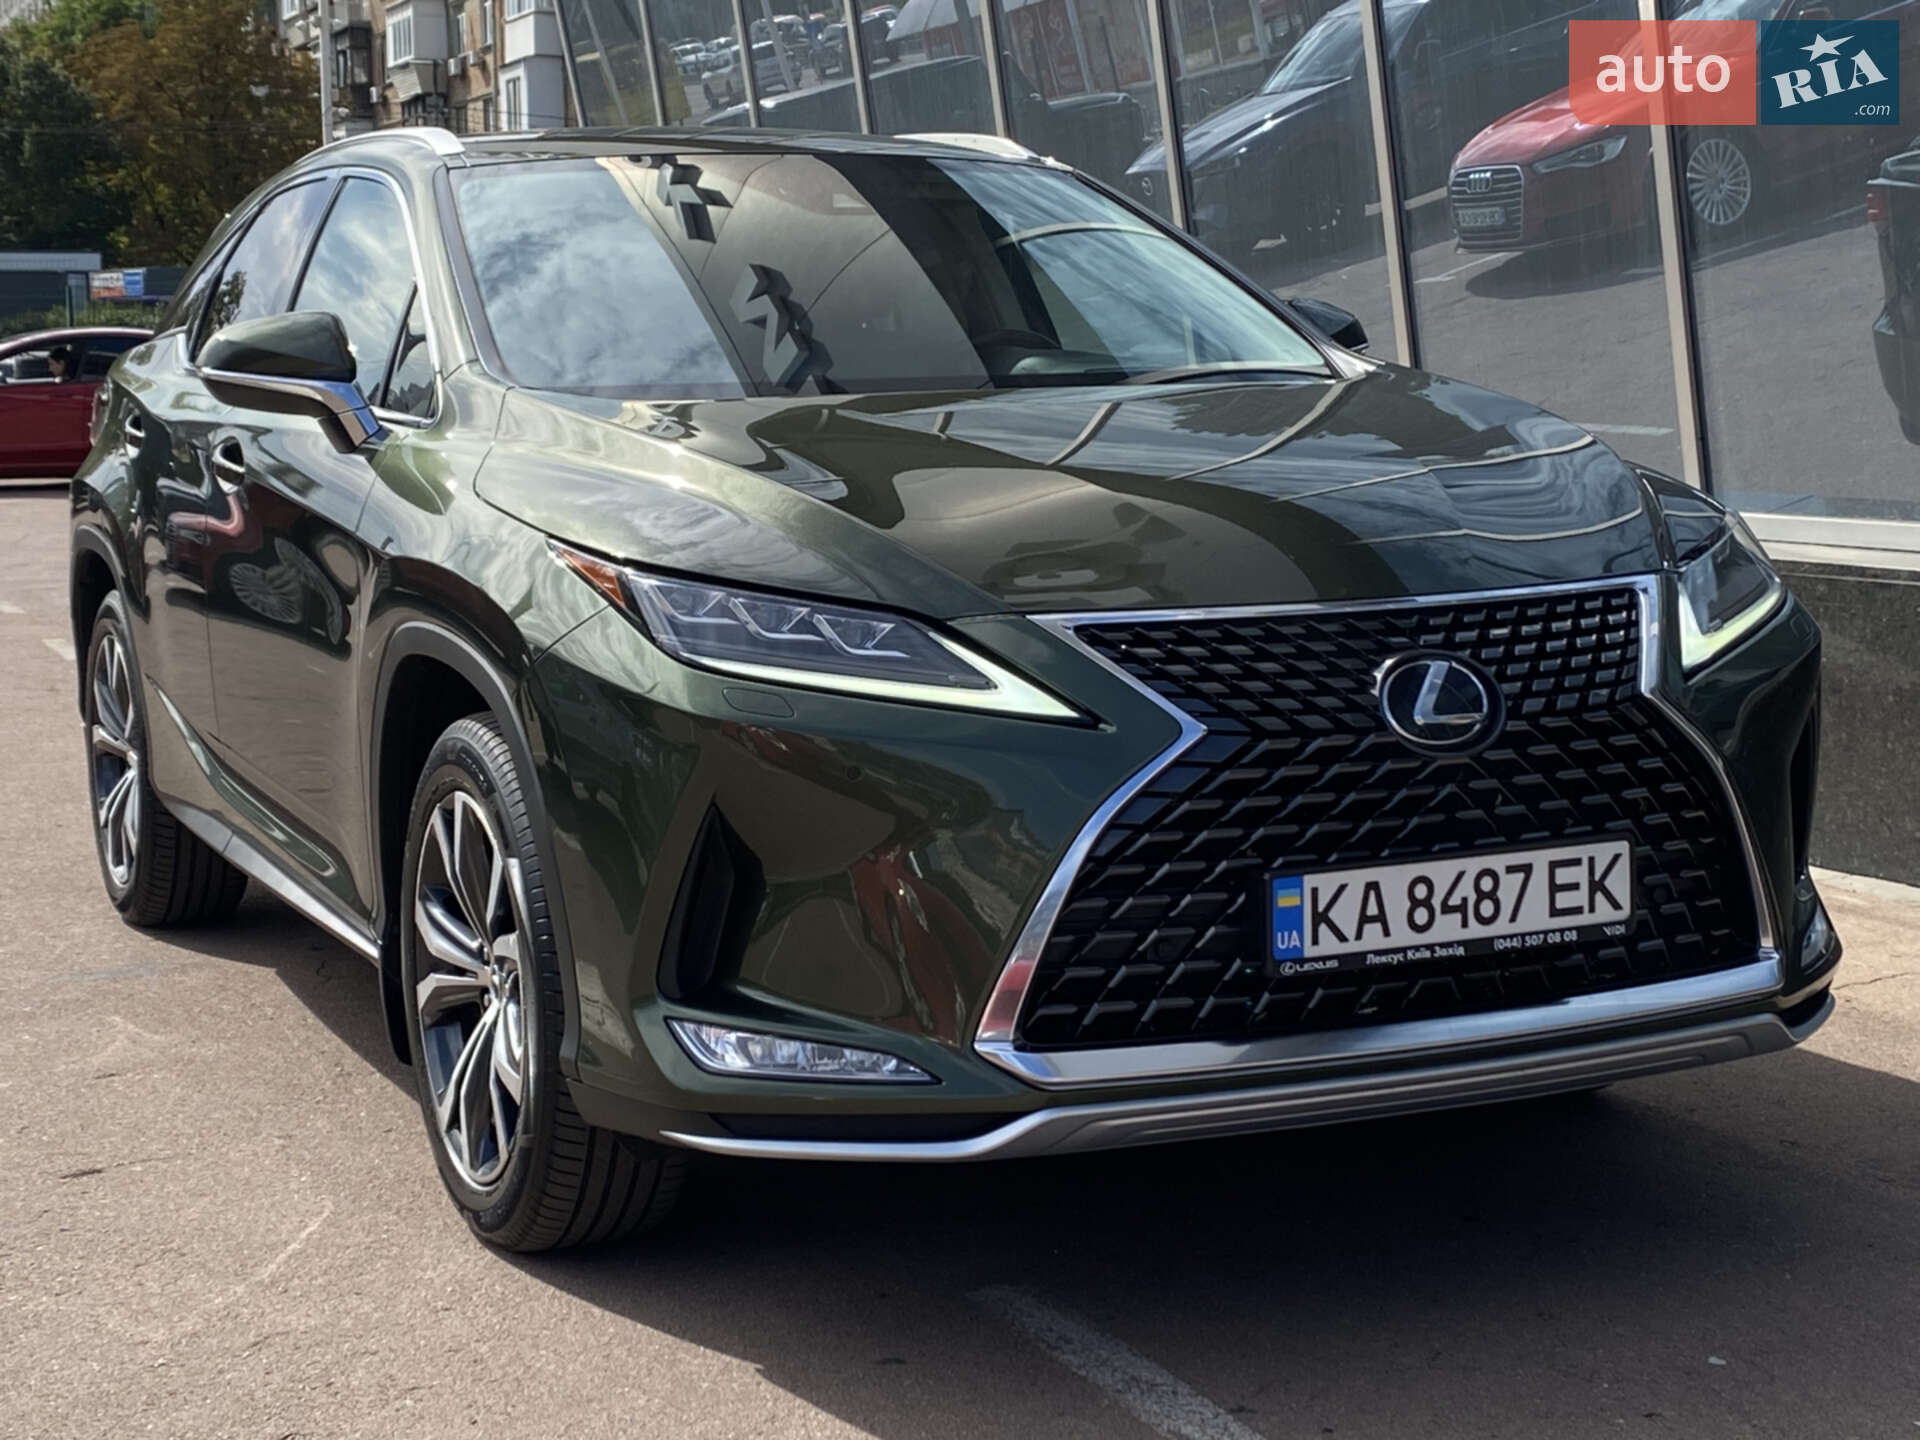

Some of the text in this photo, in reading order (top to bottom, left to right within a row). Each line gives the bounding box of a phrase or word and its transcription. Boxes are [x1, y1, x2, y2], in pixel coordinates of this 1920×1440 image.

[1310, 853, 1624, 946] KA 8487 EK
[1277, 931, 1301, 949] UA
[1494, 936, 1521, 951] (044)
[1524, 934, 1544, 946] 507
[1366, 953, 1404, 965] Лексус
[1434, 944, 1465, 957] Захід
[1296, 959, 1339, 972] LEXUS
